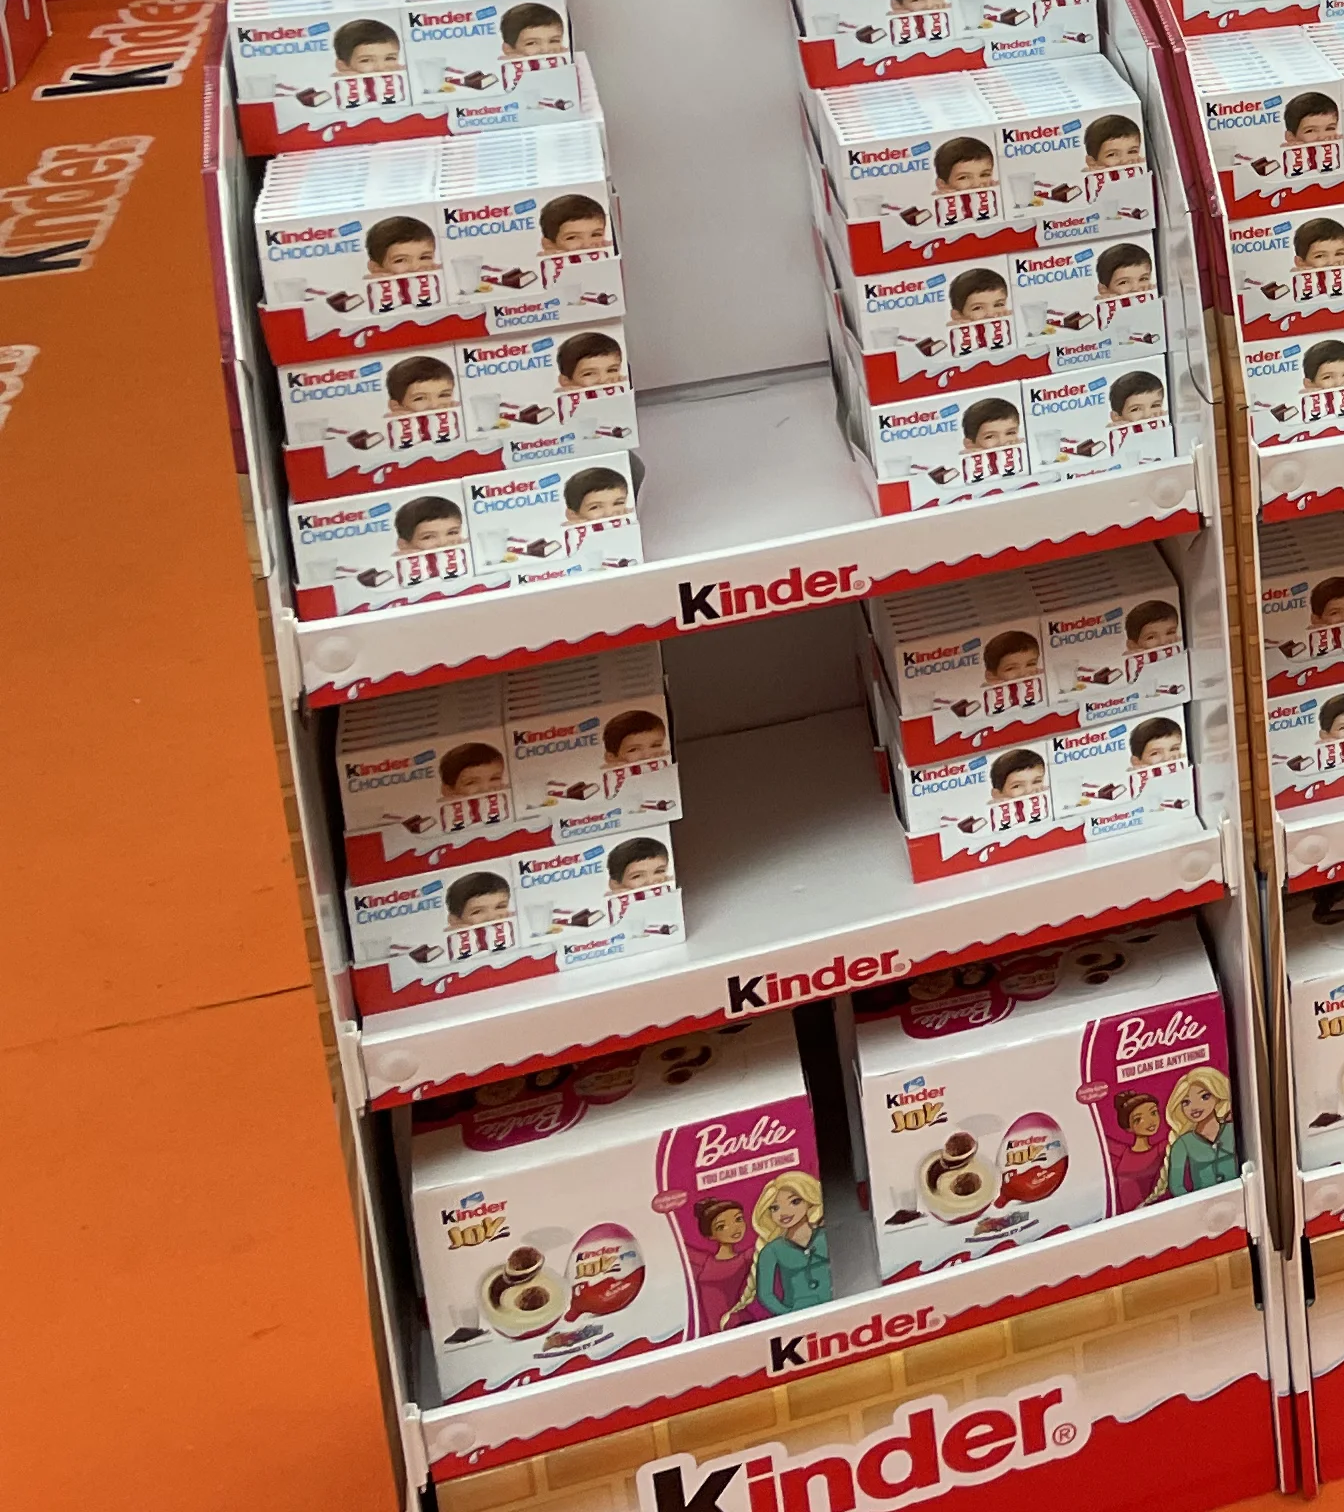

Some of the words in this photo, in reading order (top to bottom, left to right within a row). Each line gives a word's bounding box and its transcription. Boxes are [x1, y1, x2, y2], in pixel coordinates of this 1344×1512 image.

[409, 9, 473, 27] Kinder
[238, 26, 306, 43] Kinder
[411, 22, 496, 41] CHOCOLATE
[241, 37, 329, 58] CHOCOLATE
[1206, 99, 1262, 117] Kinder
[1207, 112, 1280, 131] CHOCOLATE
[1002, 124, 1060, 144] Kinder
[849, 146, 909, 165] Kinder
[1004, 135, 1081, 158] CHOCOLATE
[850, 157, 930, 180] CHOCOLATE
[444, 203, 512, 224] Kinder
[265, 225, 336, 246] Kinder
[446, 215, 535, 240] CHOCOLATE
[268, 238, 361, 262] CHOCOLATE
[1016, 254, 1073, 273] Kinder
[1018, 265, 1092, 287] CHOCOLATE
[463, 343, 528, 363] Kinder
[466, 354, 552, 379] CHOCOLATE
[1030, 384, 1086, 403] Kinder
[1032, 393, 1105, 416] CHOCOLATE
[678, 564, 859, 626] Kinder
[1053, 731, 1107, 751] Kinder
[1055, 740, 1126, 764] CHOCOLATE
[354, 887, 419, 910] Kinder
[357, 897, 441, 924] CHOCOLATE
[727, 950, 900, 1014] Kinder
[1116, 1010, 1207, 1060] Barbie
[1121, 1066, 1135, 1078] YOU
[1137, 1062, 1153, 1074] CAN
[1155, 1058, 1163, 1069] BE
[1166, 1049, 1205, 1065] ANYTHING
[886, 1086, 946, 1108] Kinder
[890, 1101, 947, 1133] JOY
[695, 1116, 796, 1168] Barbie
[702, 1172, 717, 1185] YOU
[719, 1169, 737, 1181] CAN
[739, 1165, 749, 1176] BE
[751, 1152, 795, 1172] ANYTHING
[441, 1200, 508, 1224] Kinder
[448, 1216, 510, 1250] JOY
[770, 1305, 935, 1372] Kinder
